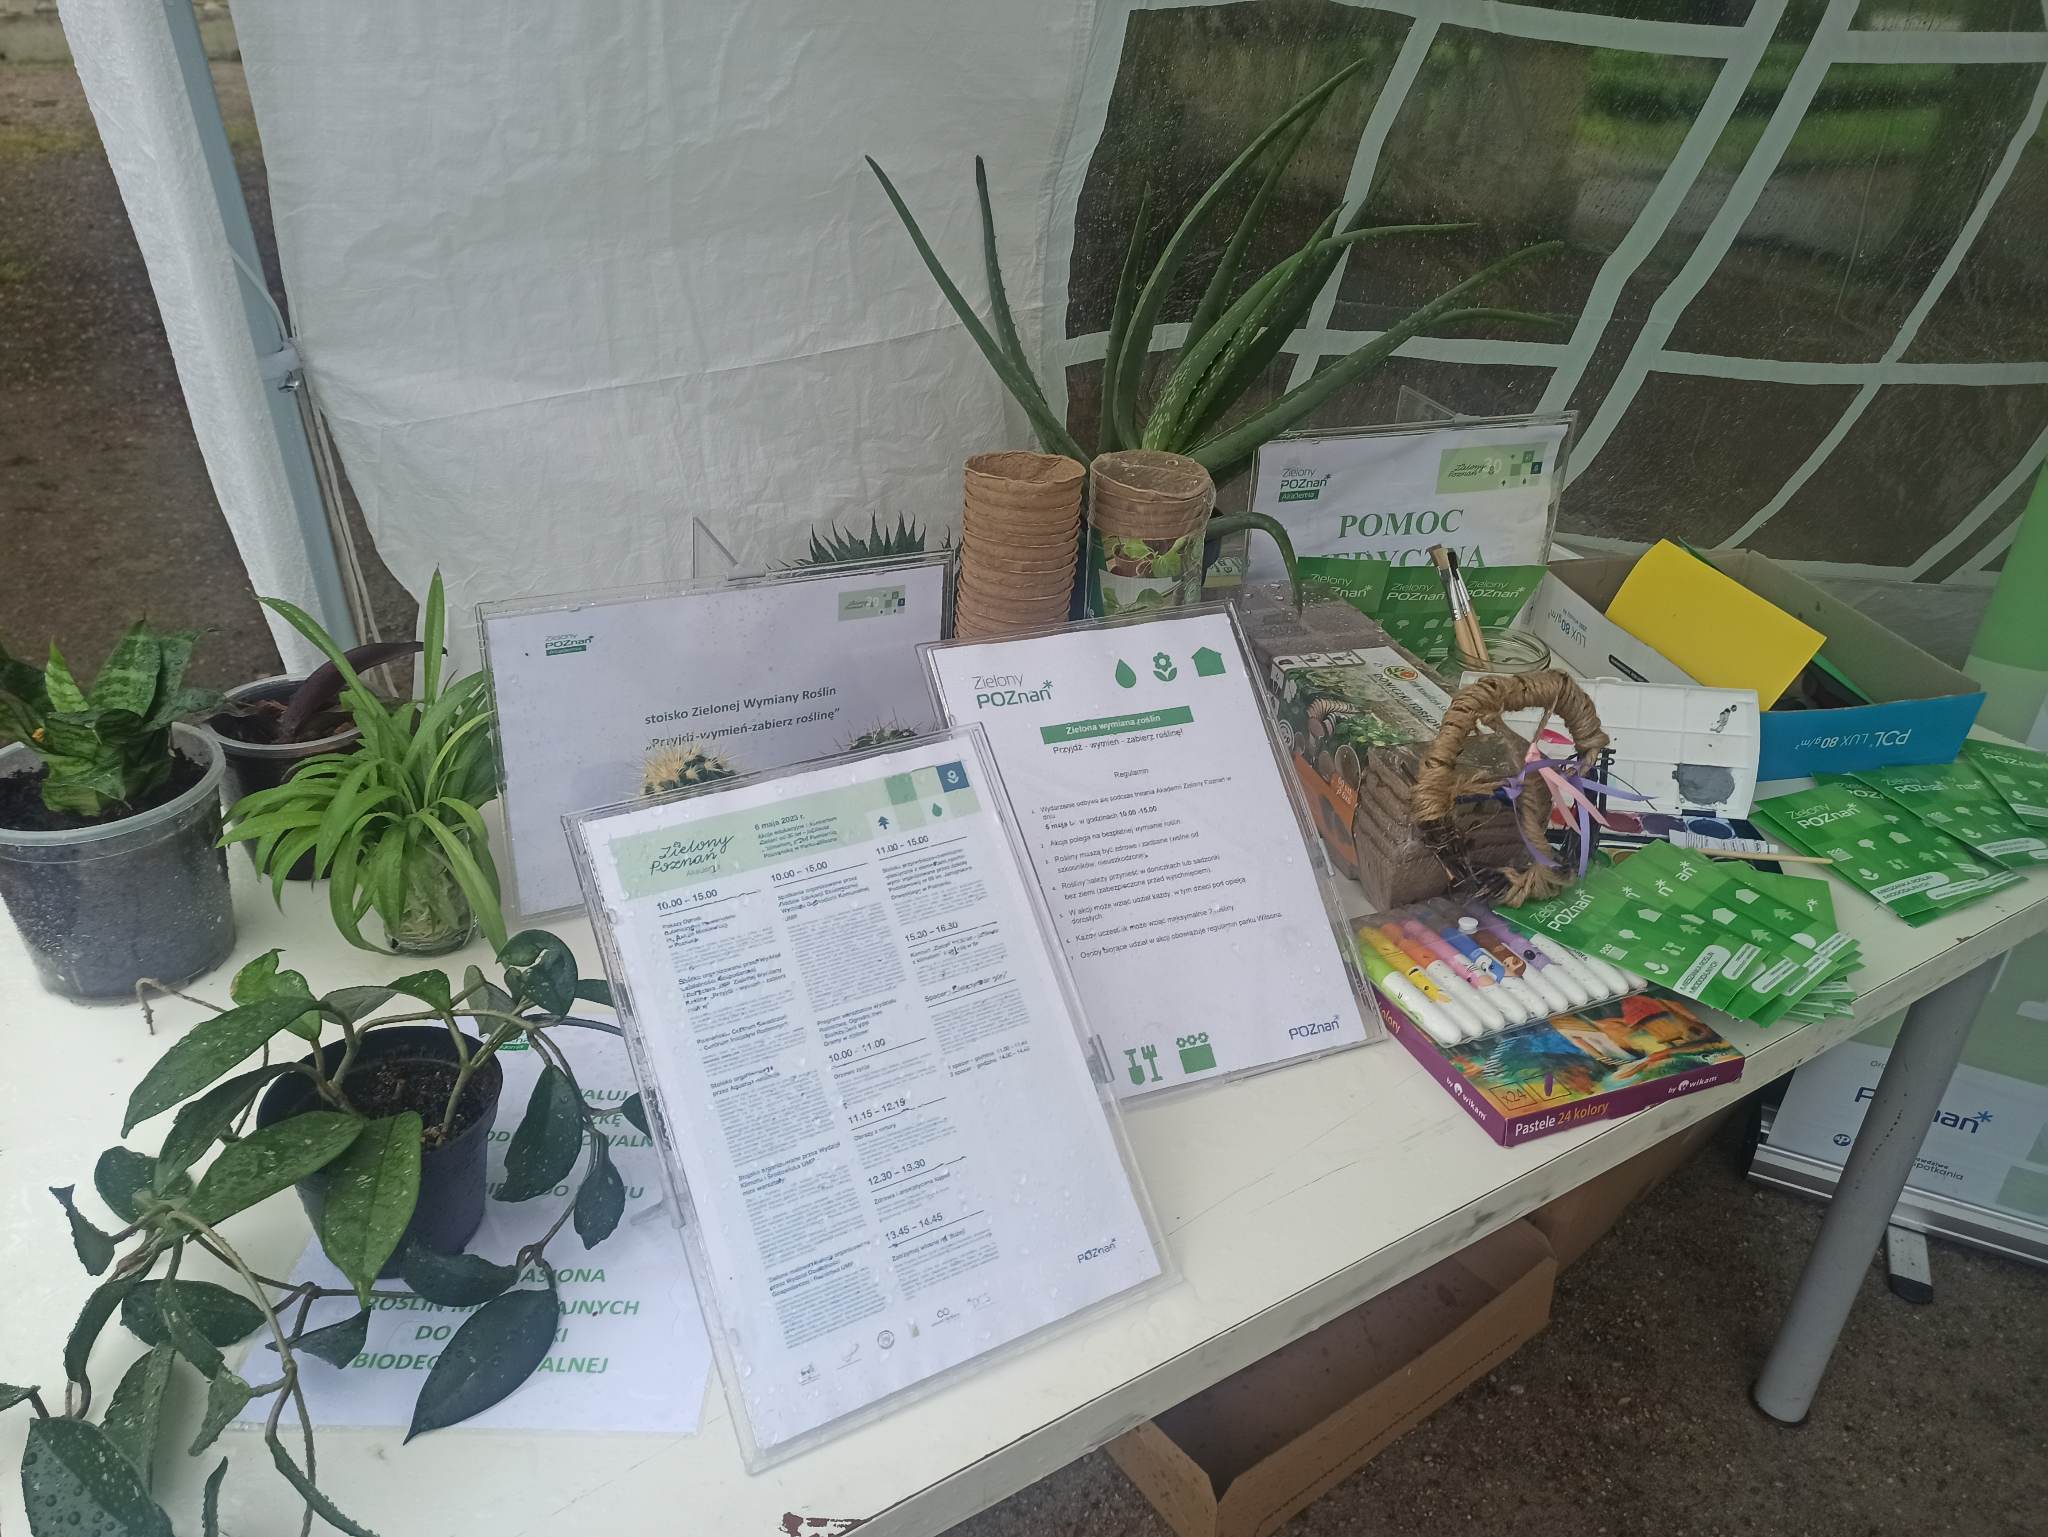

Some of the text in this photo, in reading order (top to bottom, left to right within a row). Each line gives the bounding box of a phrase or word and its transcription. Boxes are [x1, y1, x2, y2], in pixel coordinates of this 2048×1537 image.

[1338, 508, 1464, 539] POMOC
[1391, 582, 1434, 593] Zielony
[972, 673, 1024, 690] Zielony
[644, 686, 837, 726] stoisko Zielonej Wymiany Roślin
[1066, 713, 1162, 736] Zielona wymiana roślin
[1840, 733, 1869, 747] LUX
[760, 819, 780, 830] maja
[659, 834, 734, 861] Zielony
[874, 834, 929, 855] 11.00 15.00
[1069, 834, 1092, 844] polega
[650, 851, 717, 879] Poznań
[770, 869, 795, 882] 10.00
[655, 888, 718, 911] 10.00 15.00
[935, 920, 959, 934] 16.30
[827, 1047, 853, 1063] 10.00
[1667, 1075, 1717, 1095] by wikam
[1461, 1093, 1487, 1120] wikam
[847, 1108, 873, 1125] 11.15
[1514, 1101, 1609, 1137] Pastele 24 kolory
[867, 1157, 926, 1187] 12.30 13.30
[885, 1224, 910, 1242] 13.45
[414, 1325, 451, 1341] DO
